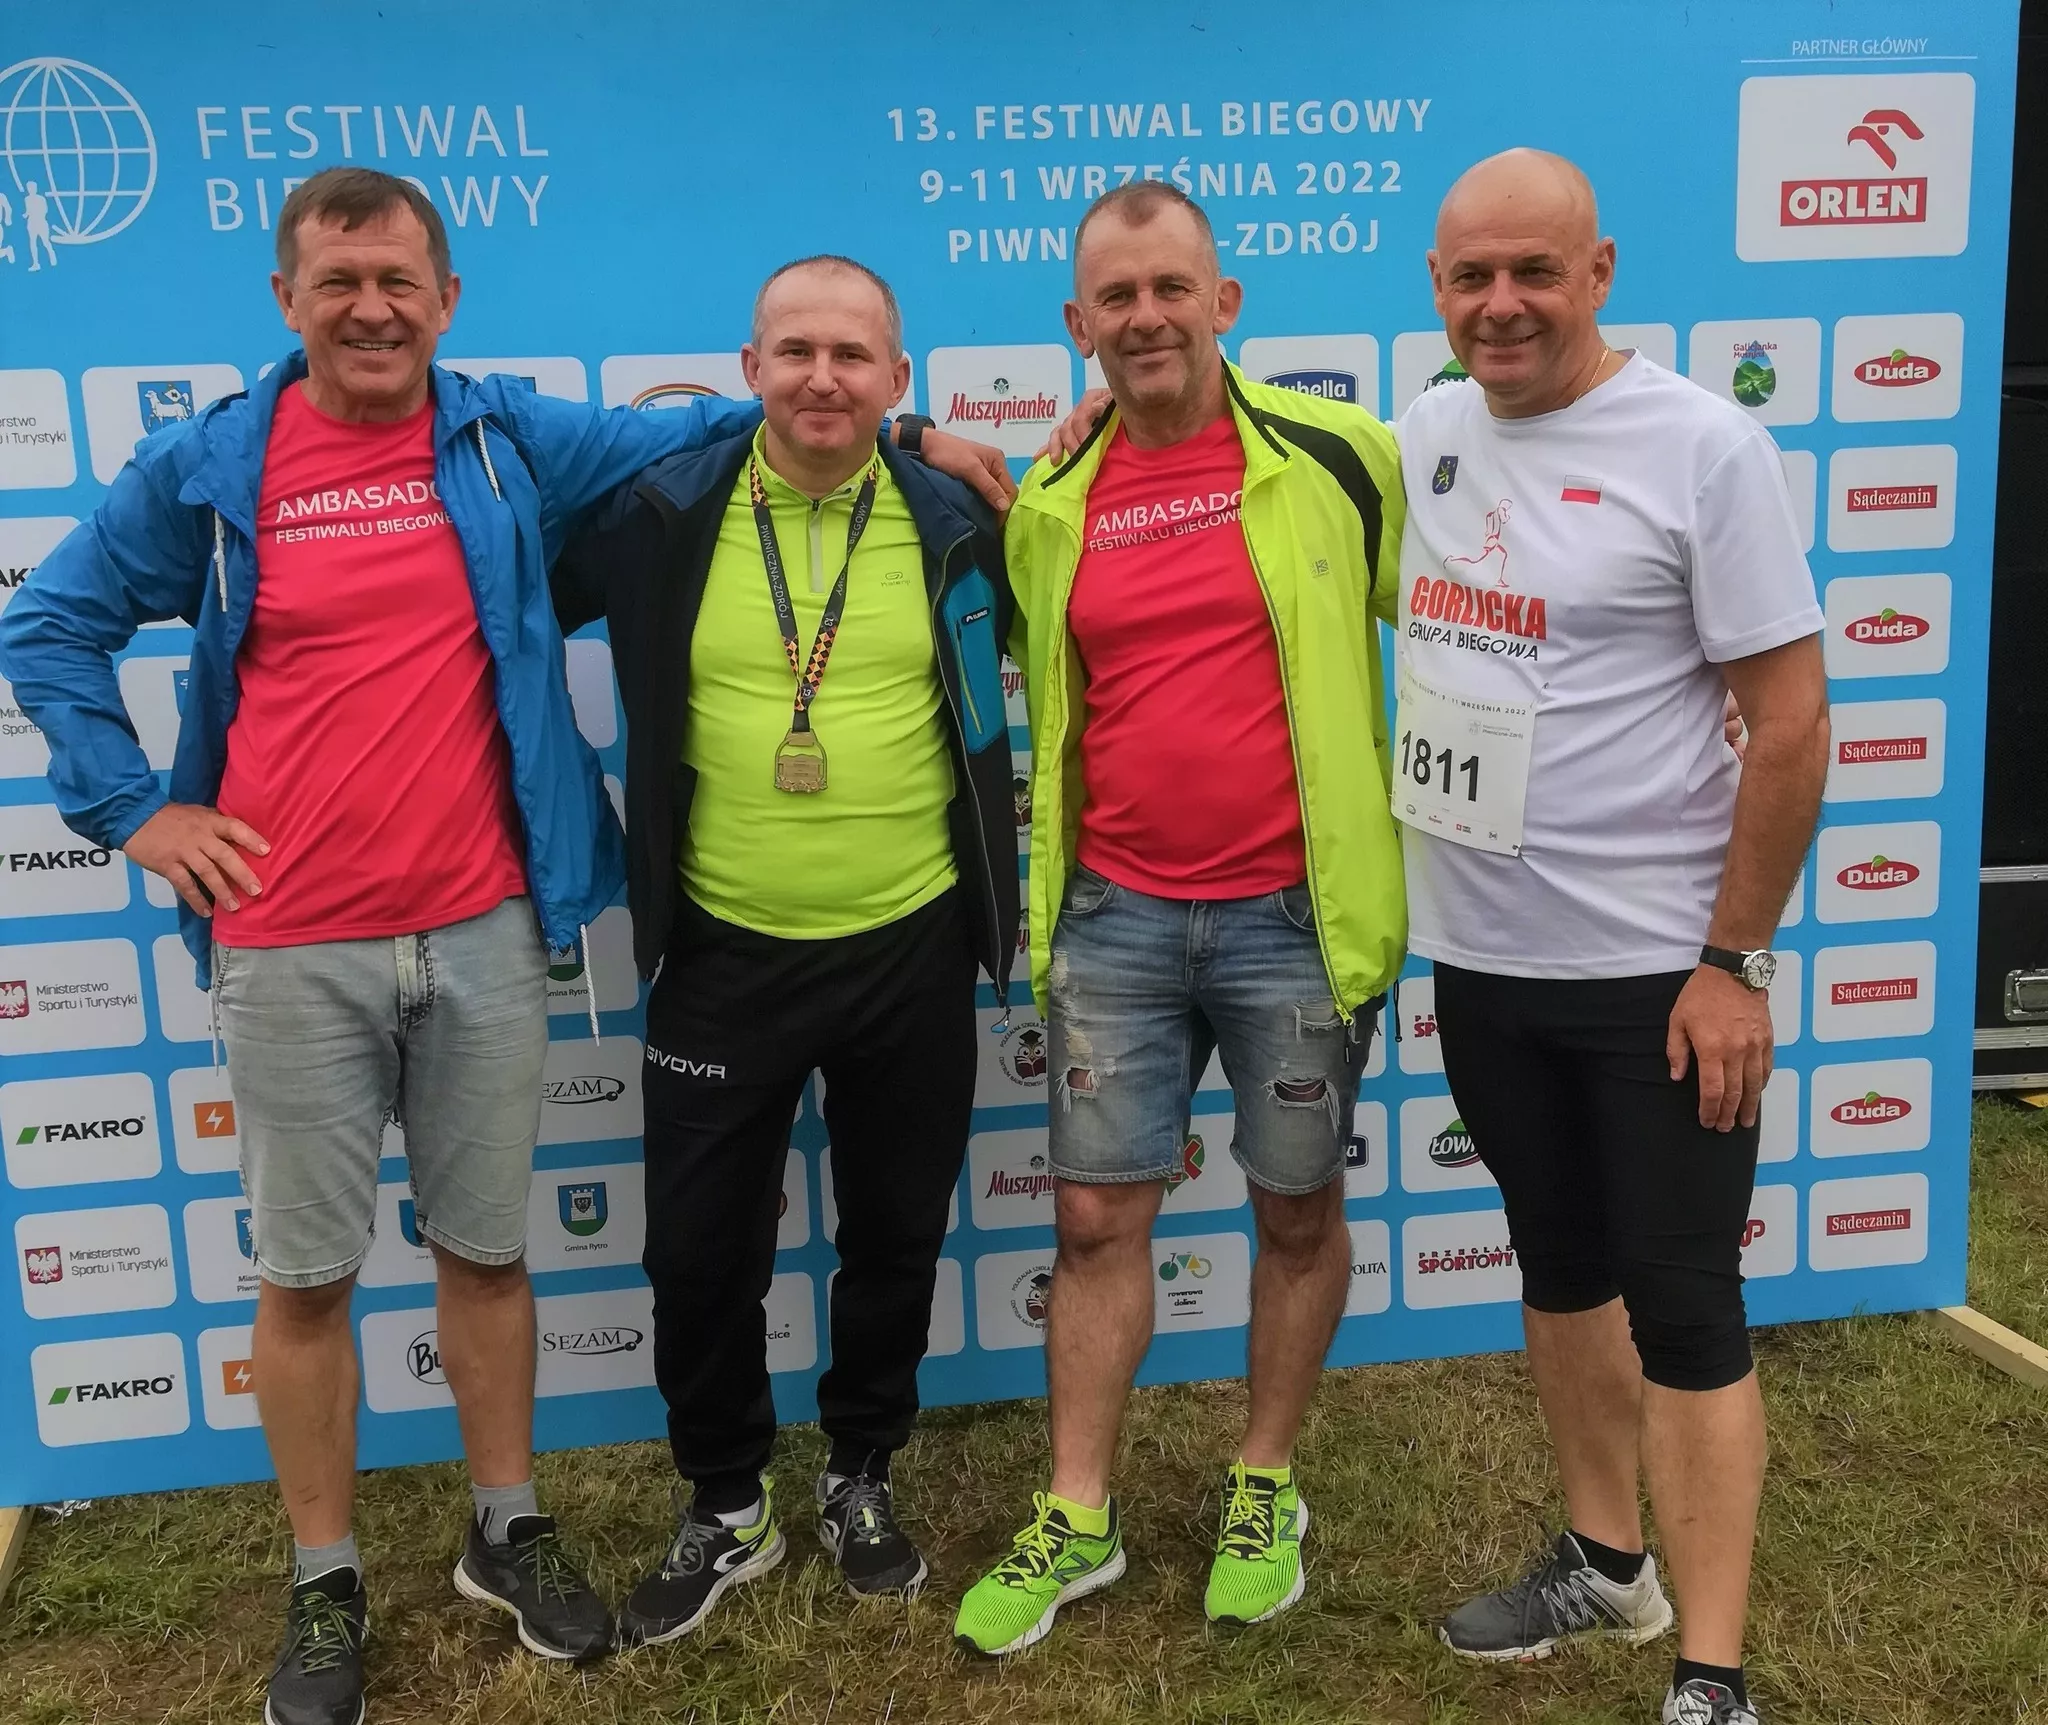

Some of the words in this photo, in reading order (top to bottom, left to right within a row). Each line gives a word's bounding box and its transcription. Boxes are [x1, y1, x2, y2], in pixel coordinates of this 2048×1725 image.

[1792, 40, 1858, 55] PARTNER
[1861, 36, 1928, 55] GŁÓWNY
[196, 104, 549, 160] FESTIWAL
[887, 107, 956, 142] 13.
[975, 104, 1202, 140] FESTIWAL
[1221, 99, 1432, 136] BIEGOWY
[920, 168, 1016, 203] 9-11
[1295, 160, 1402, 195] 2022
[206, 175, 550, 231] BIWY
[1788, 184, 1918, 220] ORLEN
[1864, 362, 1929, 381] Duda
[945, 392, 1057, 428] Muszynianka
[11, 430, 67, 446] Turystyki
[1852, 487, 1931, 510] Sądeczanin
[275, 521, 373, 544] FESTIWALU
[1089, 529, 1171, 553] FESTIWALU
[759, 524, 790, 619] PIWNICZNA-ZDRÓJ
[1410, 576, 1547, 641] GORLICKA
[1408, 621, 1451, 646] GRUPA
[1457, 631, 1538, 661] BIEGOWA
[1855, 621, 1918, 639] Duda
[1461, 700, 1501, 713] WRZEŚNIA
[1505, 707, 1527, 715] 2022
[1844, 740, 1921, 762] Sądeczanin
[1402, 730, 1479, 802] 1811
[10, 849, 111, 872] FAKRO
[1847, 868, 1908, 885] Duda
[36, 982, 109, 996] Ministerstwo
[1836, 981, 1912, 1002] Sądeczanin
[38, 999, 77, 1012] Sportu
[87, 994, 138, 1010] Turystyki
[646, 1044, 726, 1079] GIVOVA
[1840, 1102, 1901, 1121] Duda
[45, 1118, 144, 1143] FAKRO
[1831, 1212, 1905, 1233] Sądeczanin
[69, 1246, 141, 1262] Ministerstwo
[565, 1244, 587, 1253] Gmina
[588, 1242, 608, 1251] Rytro
[71, 1264, 110, 1277] Sportu
[117, 1257, 169, 1274] Turystyki
[1418, 1251, 1514, 1274] SPORTOWY
[1168, 1289, 1203, 1297] rowerowa
[543, 1330, 622, 1352] SEZAM
[76, 1376, 174, 1402] FAKRO
